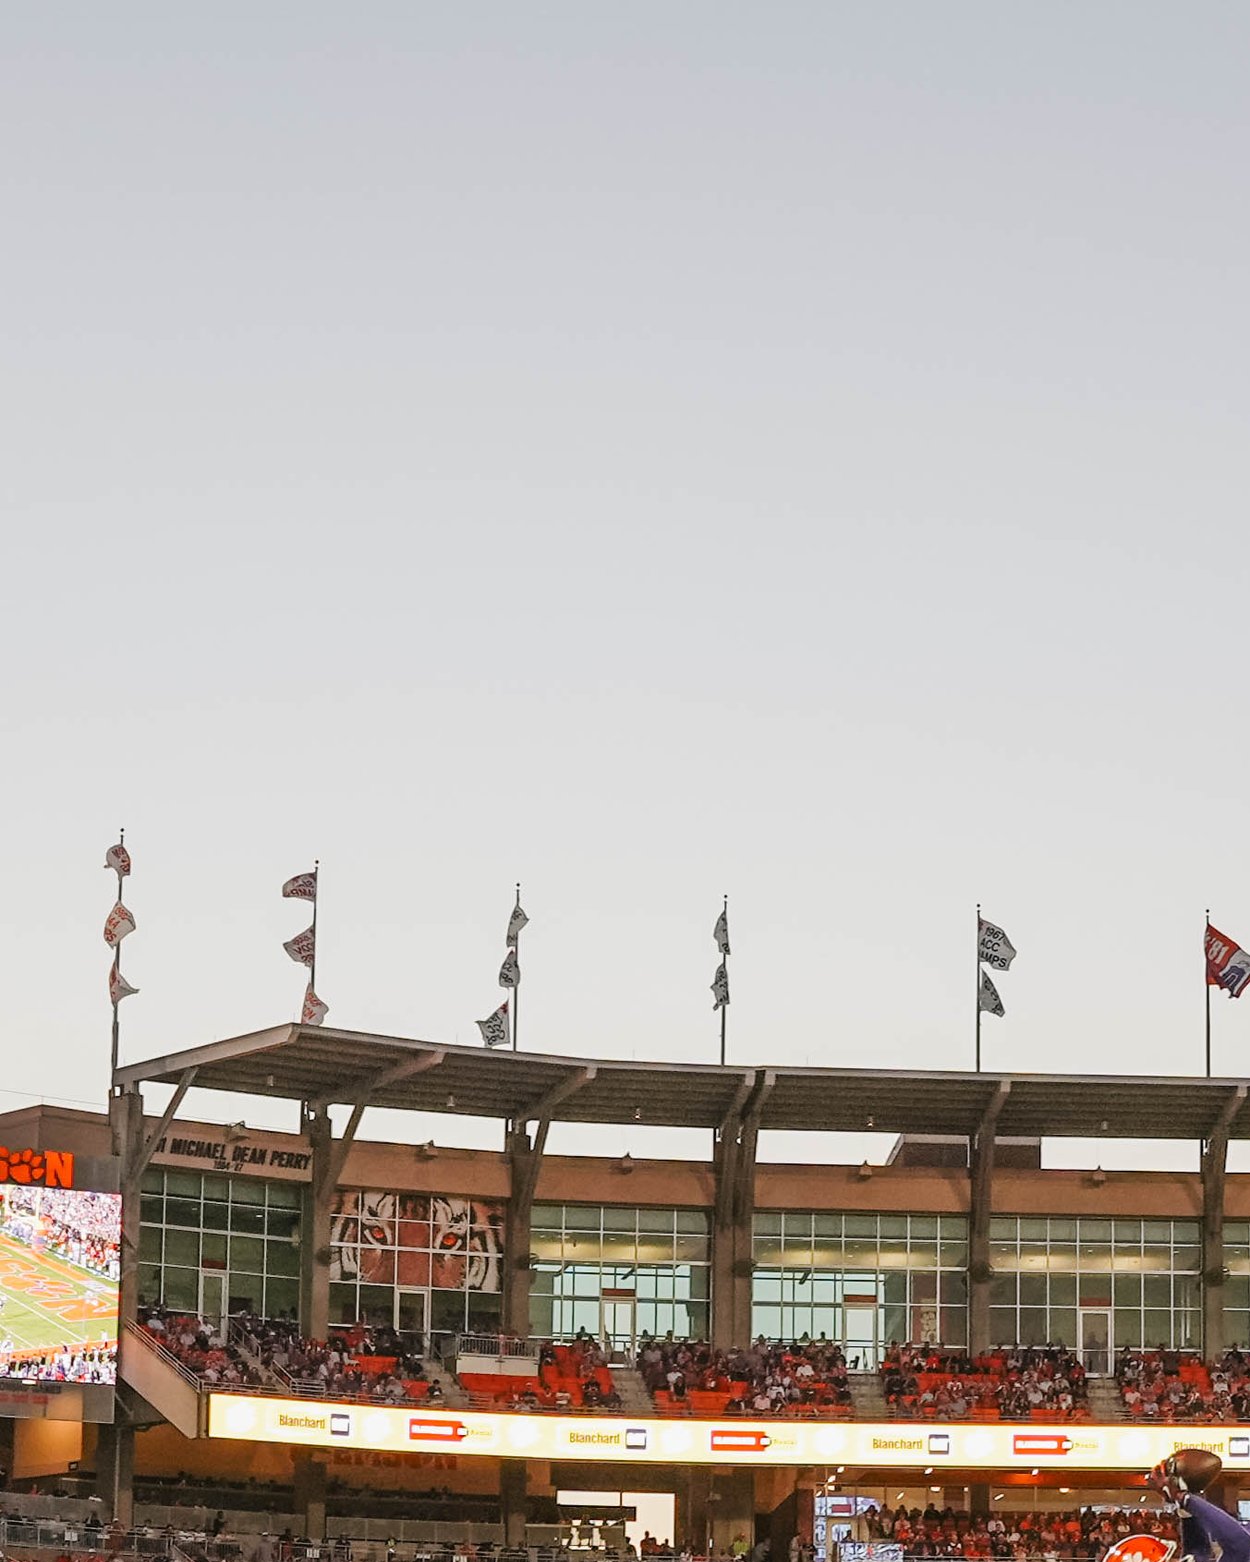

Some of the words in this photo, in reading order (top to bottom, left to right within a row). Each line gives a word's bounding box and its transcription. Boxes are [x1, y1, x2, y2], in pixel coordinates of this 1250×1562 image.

[170, 1138, 227, 1161] MICHAEL
[232, 1145, 267, 1164] DEAN
[269, 1150, 312, 1170] PERRY
[279, 1414, 325, 1430] Blanchard
[569, 1431, 620, 1445] Blanchard
[872, 1438, 923, 1450] Blanchard
